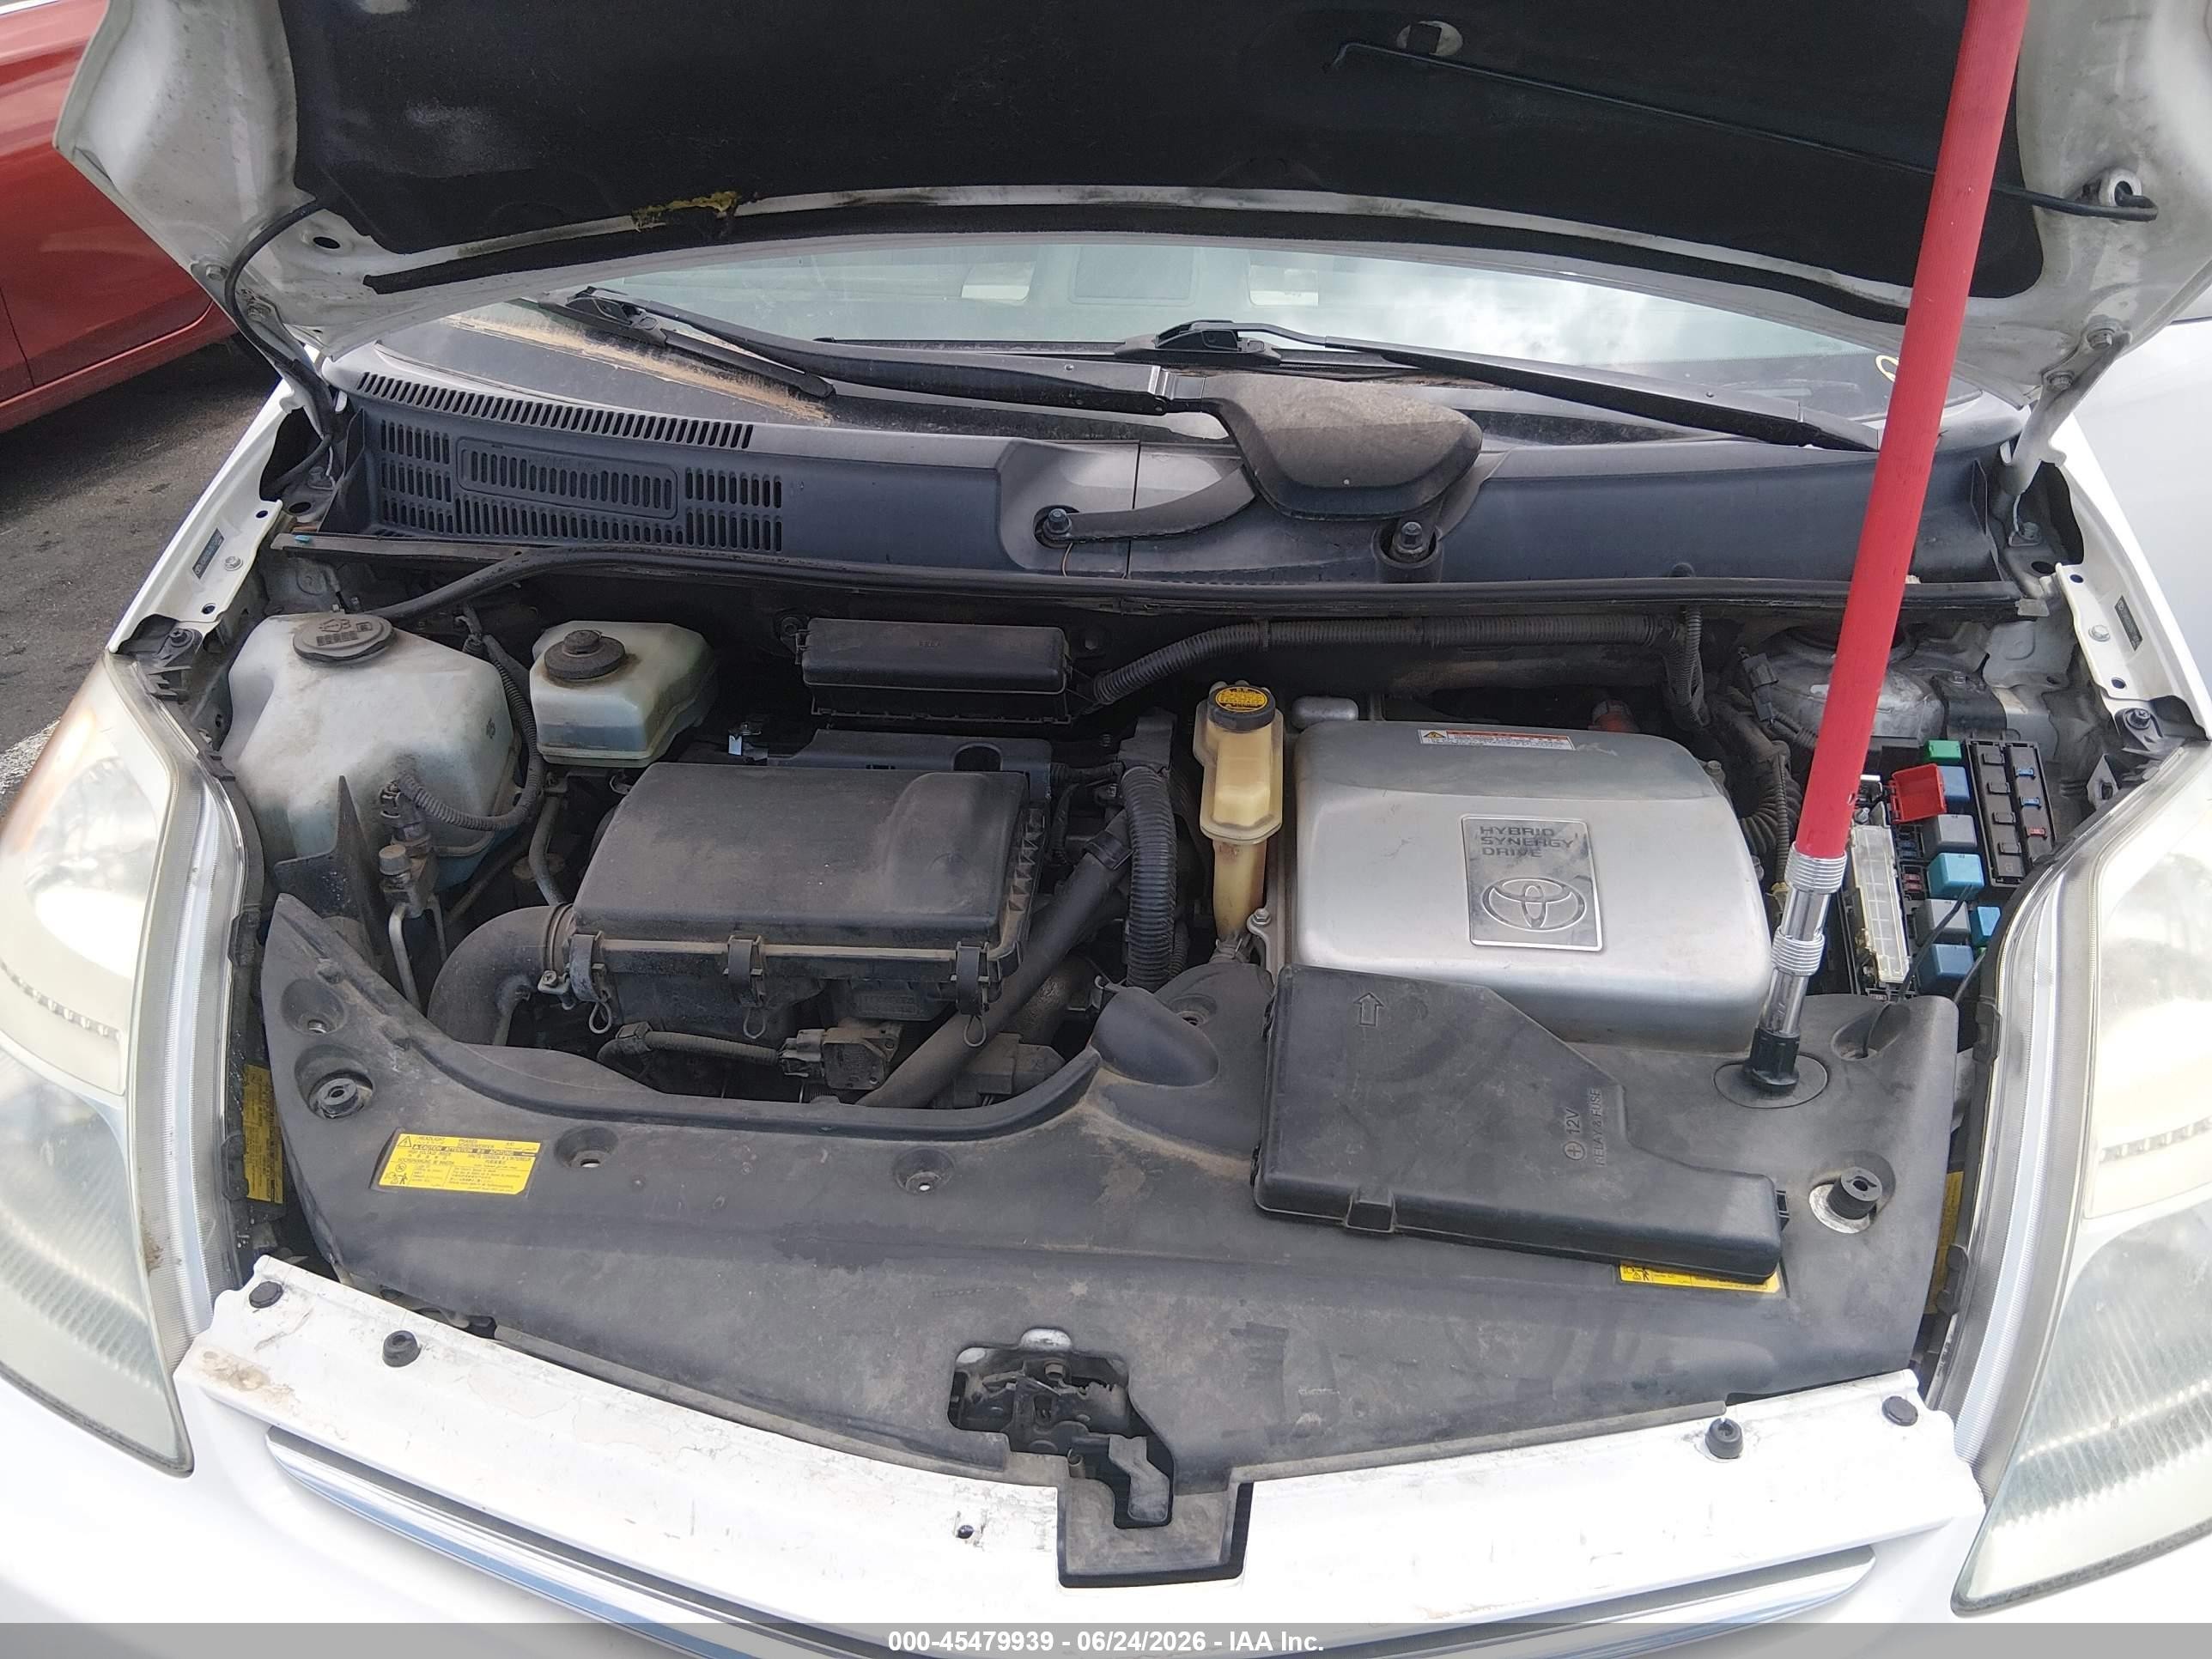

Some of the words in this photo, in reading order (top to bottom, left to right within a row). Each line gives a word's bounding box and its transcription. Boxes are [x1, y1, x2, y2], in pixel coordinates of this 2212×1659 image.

[1480, 826, 1554, 836] HYBRID
[1480, 836, 1573, 848] SYNERGY
[1482, 847, 1543, 857] DRIVE
[1589, 1088, 1602, 1117] FUSE
[1565, 1107, 1581, 1134] 12V
[1592, 1130, 1605, 1166] RELAY
